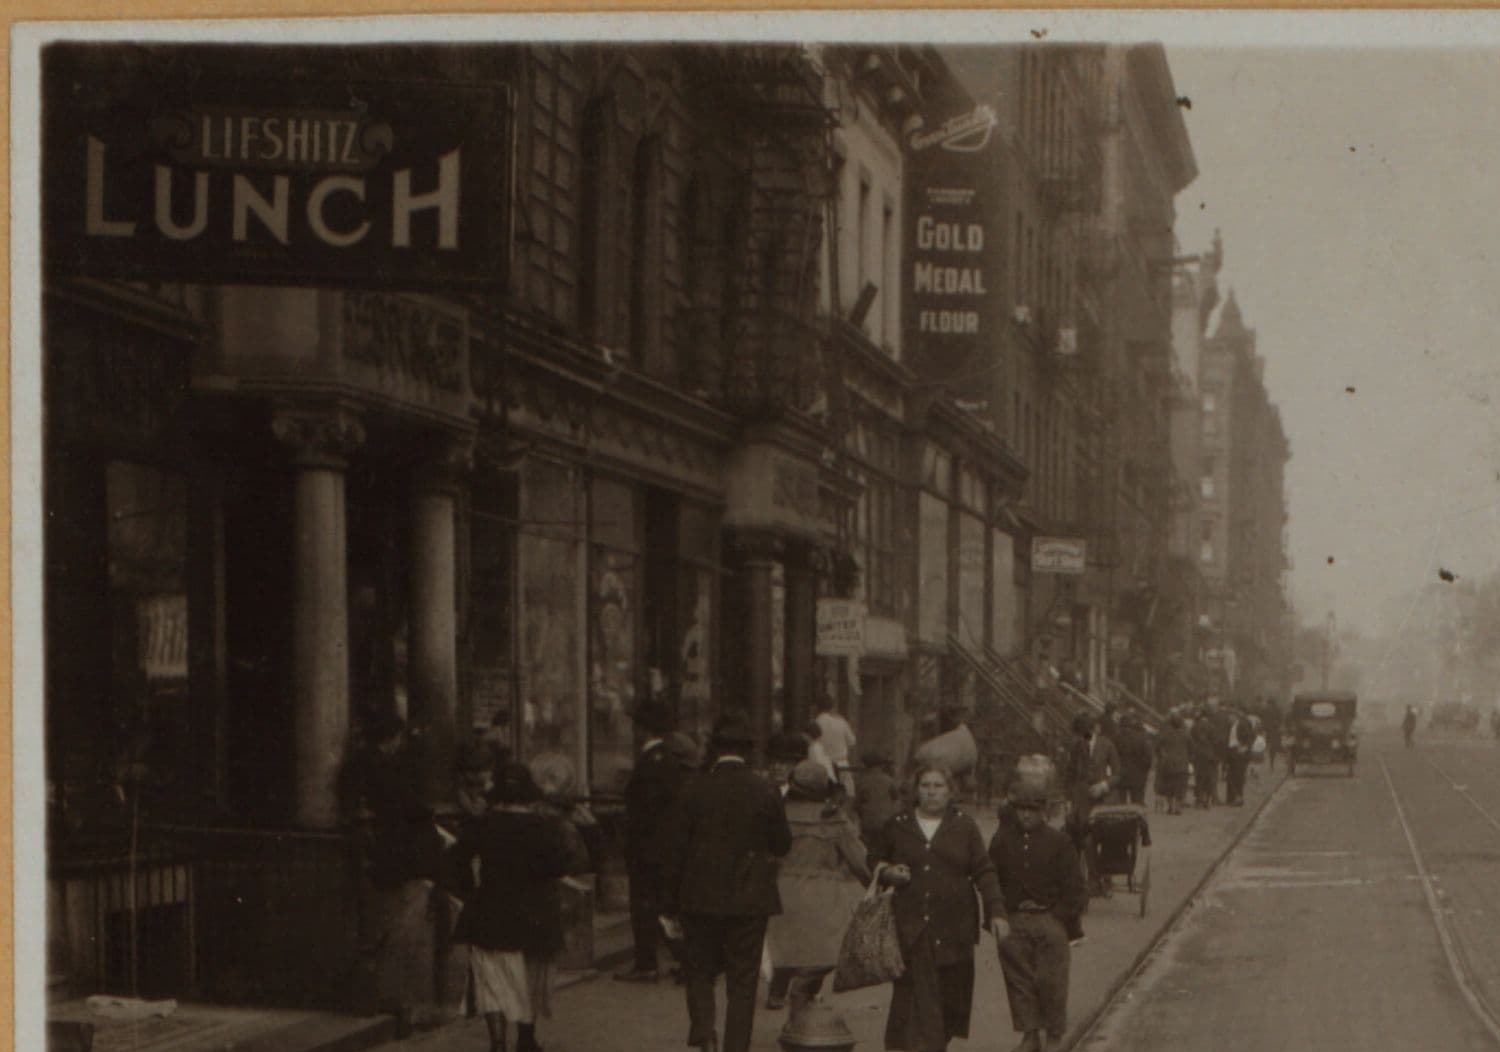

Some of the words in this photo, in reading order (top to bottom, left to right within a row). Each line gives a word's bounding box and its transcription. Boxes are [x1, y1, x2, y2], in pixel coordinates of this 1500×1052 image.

[200, 113, 361, 164] LIFSHITZ
[85, 132, 462, 251] LUNCH
[917, 215, 984, 251] GOLD
[913, 261, 987, 295] MEDAL
[919, 308, 979, 334] FLOUR
